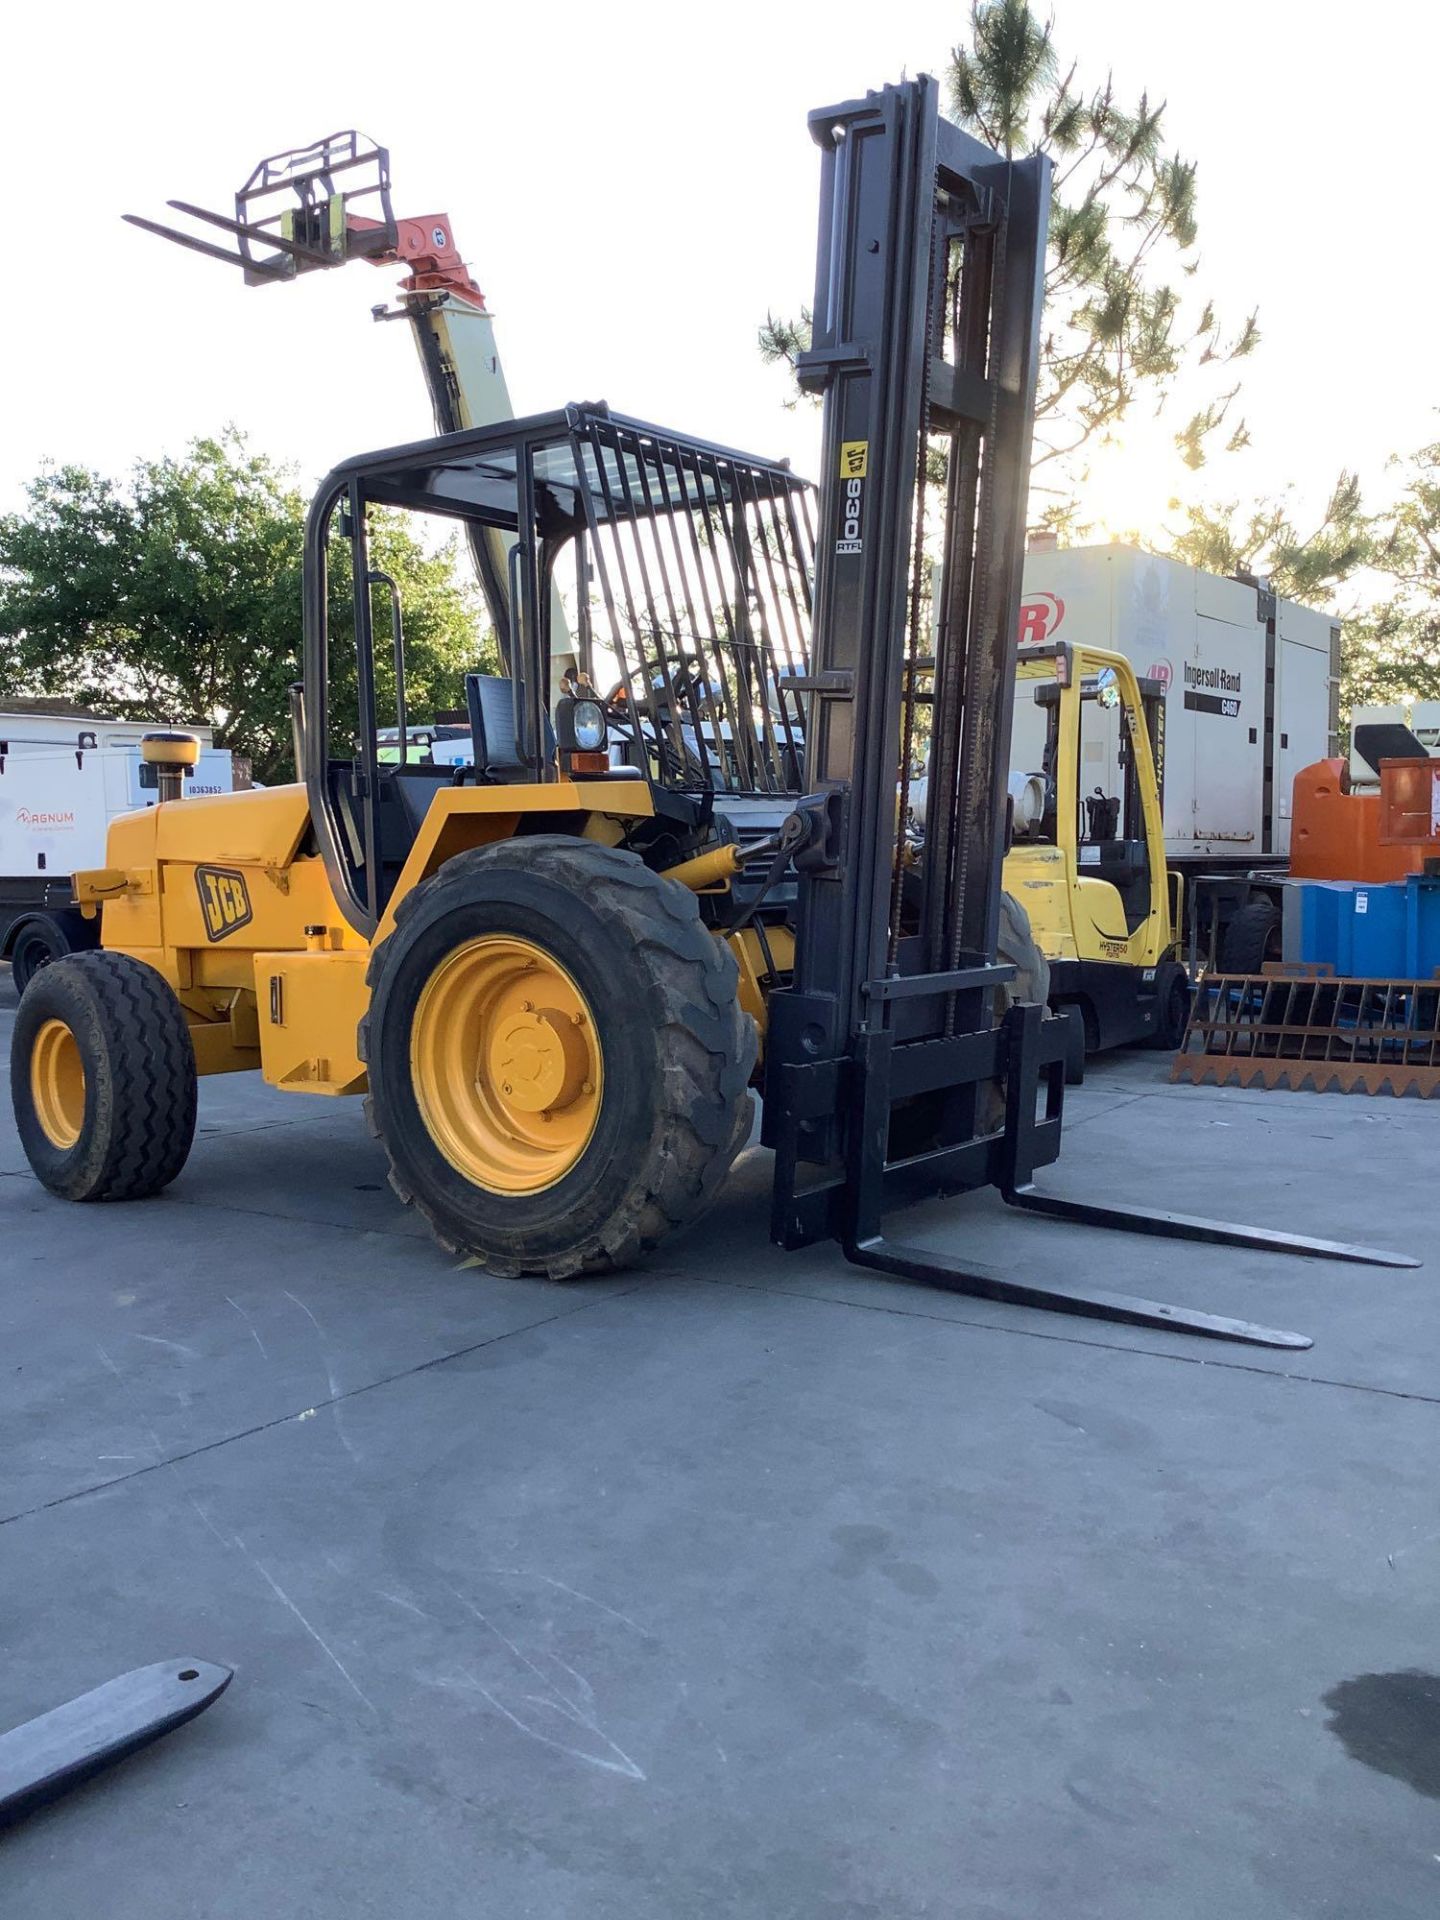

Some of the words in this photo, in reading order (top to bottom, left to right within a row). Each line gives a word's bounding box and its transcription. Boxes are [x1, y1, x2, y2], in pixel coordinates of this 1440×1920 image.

[846, 448, 866, 473] JCB
[844, 478, 862, 540] 930
[837, 543, 863, 552] RTFL
[1221, 699, 1239, 716] G460
[1156, 704, 1165, 784] HYSTER
[16, 807, 74, 824] MAGNUM
[204, 874, 247, 933] JCB
[1099, 941, 1120, 952] HYSTER
